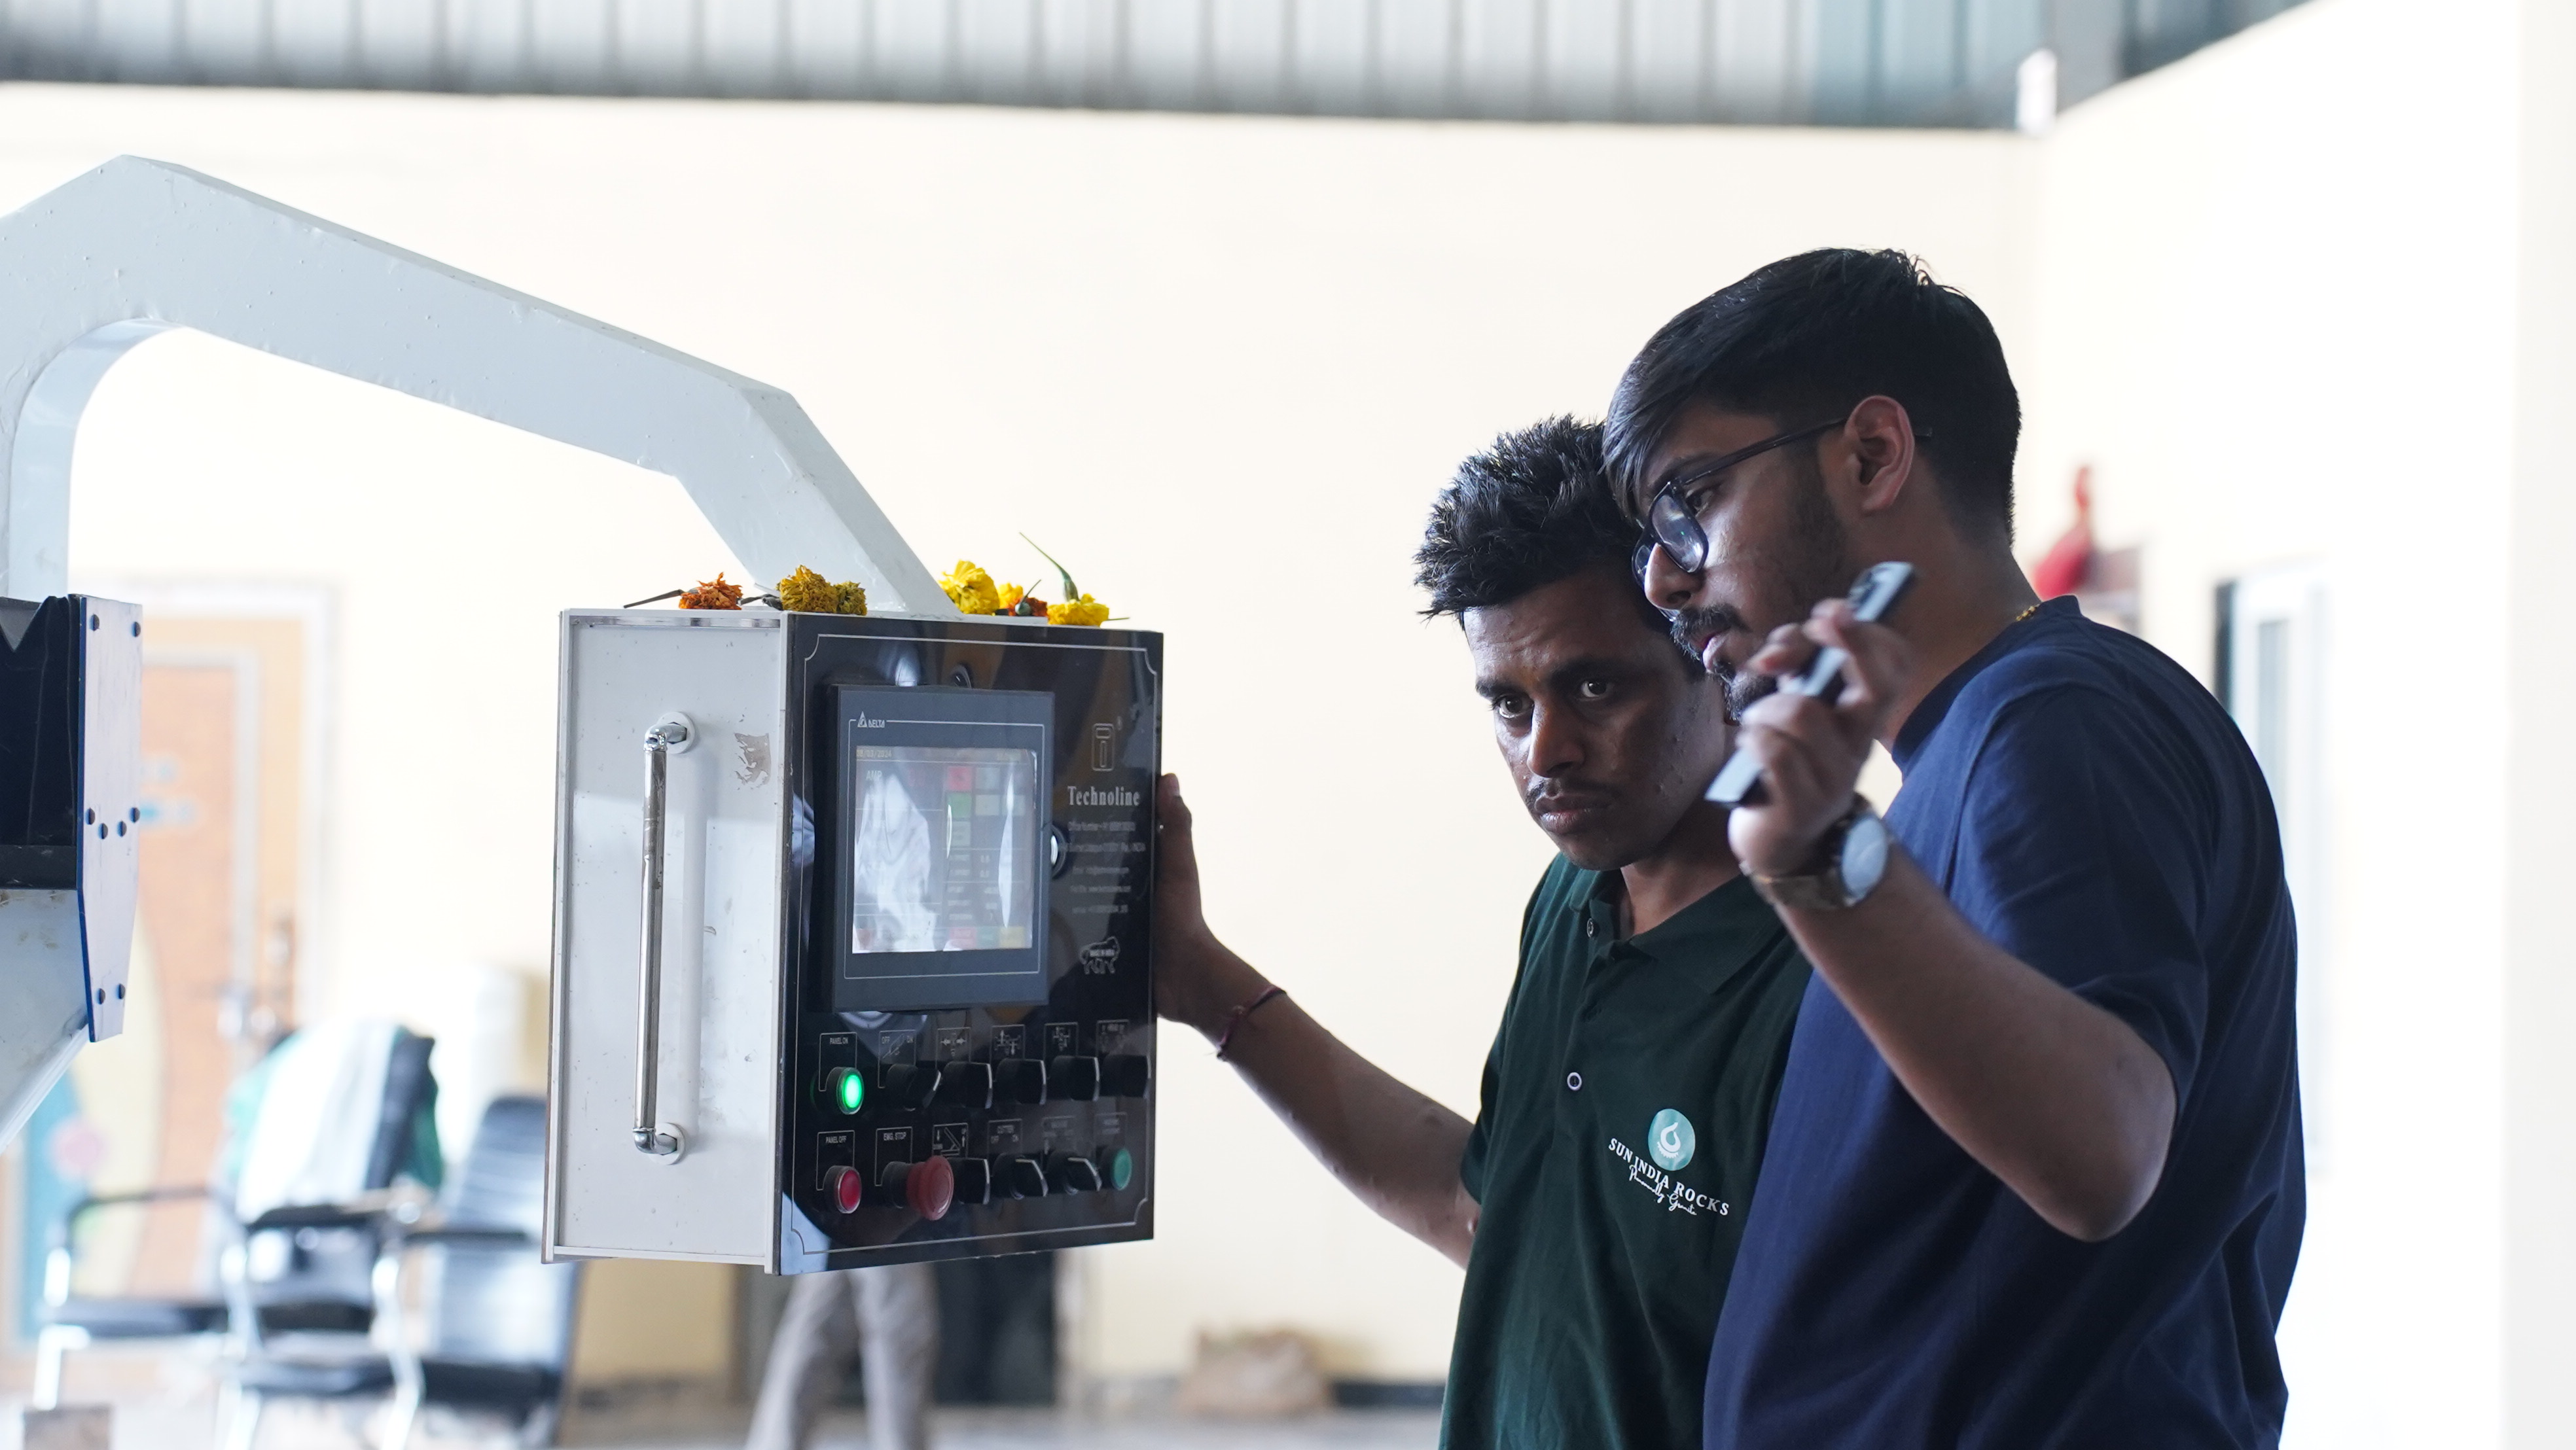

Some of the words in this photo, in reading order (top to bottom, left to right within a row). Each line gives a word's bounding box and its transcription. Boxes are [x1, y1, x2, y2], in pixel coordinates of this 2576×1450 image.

[868, 719, 885, 728] DELTA
[1067, 785, 1139, 806] Technoline
[1608, 1138, 1634, 1163] SUN
[1634, 1156, 1669, 1189] INDIA
[1673, 1181, 1729, 1216] ROCKS
